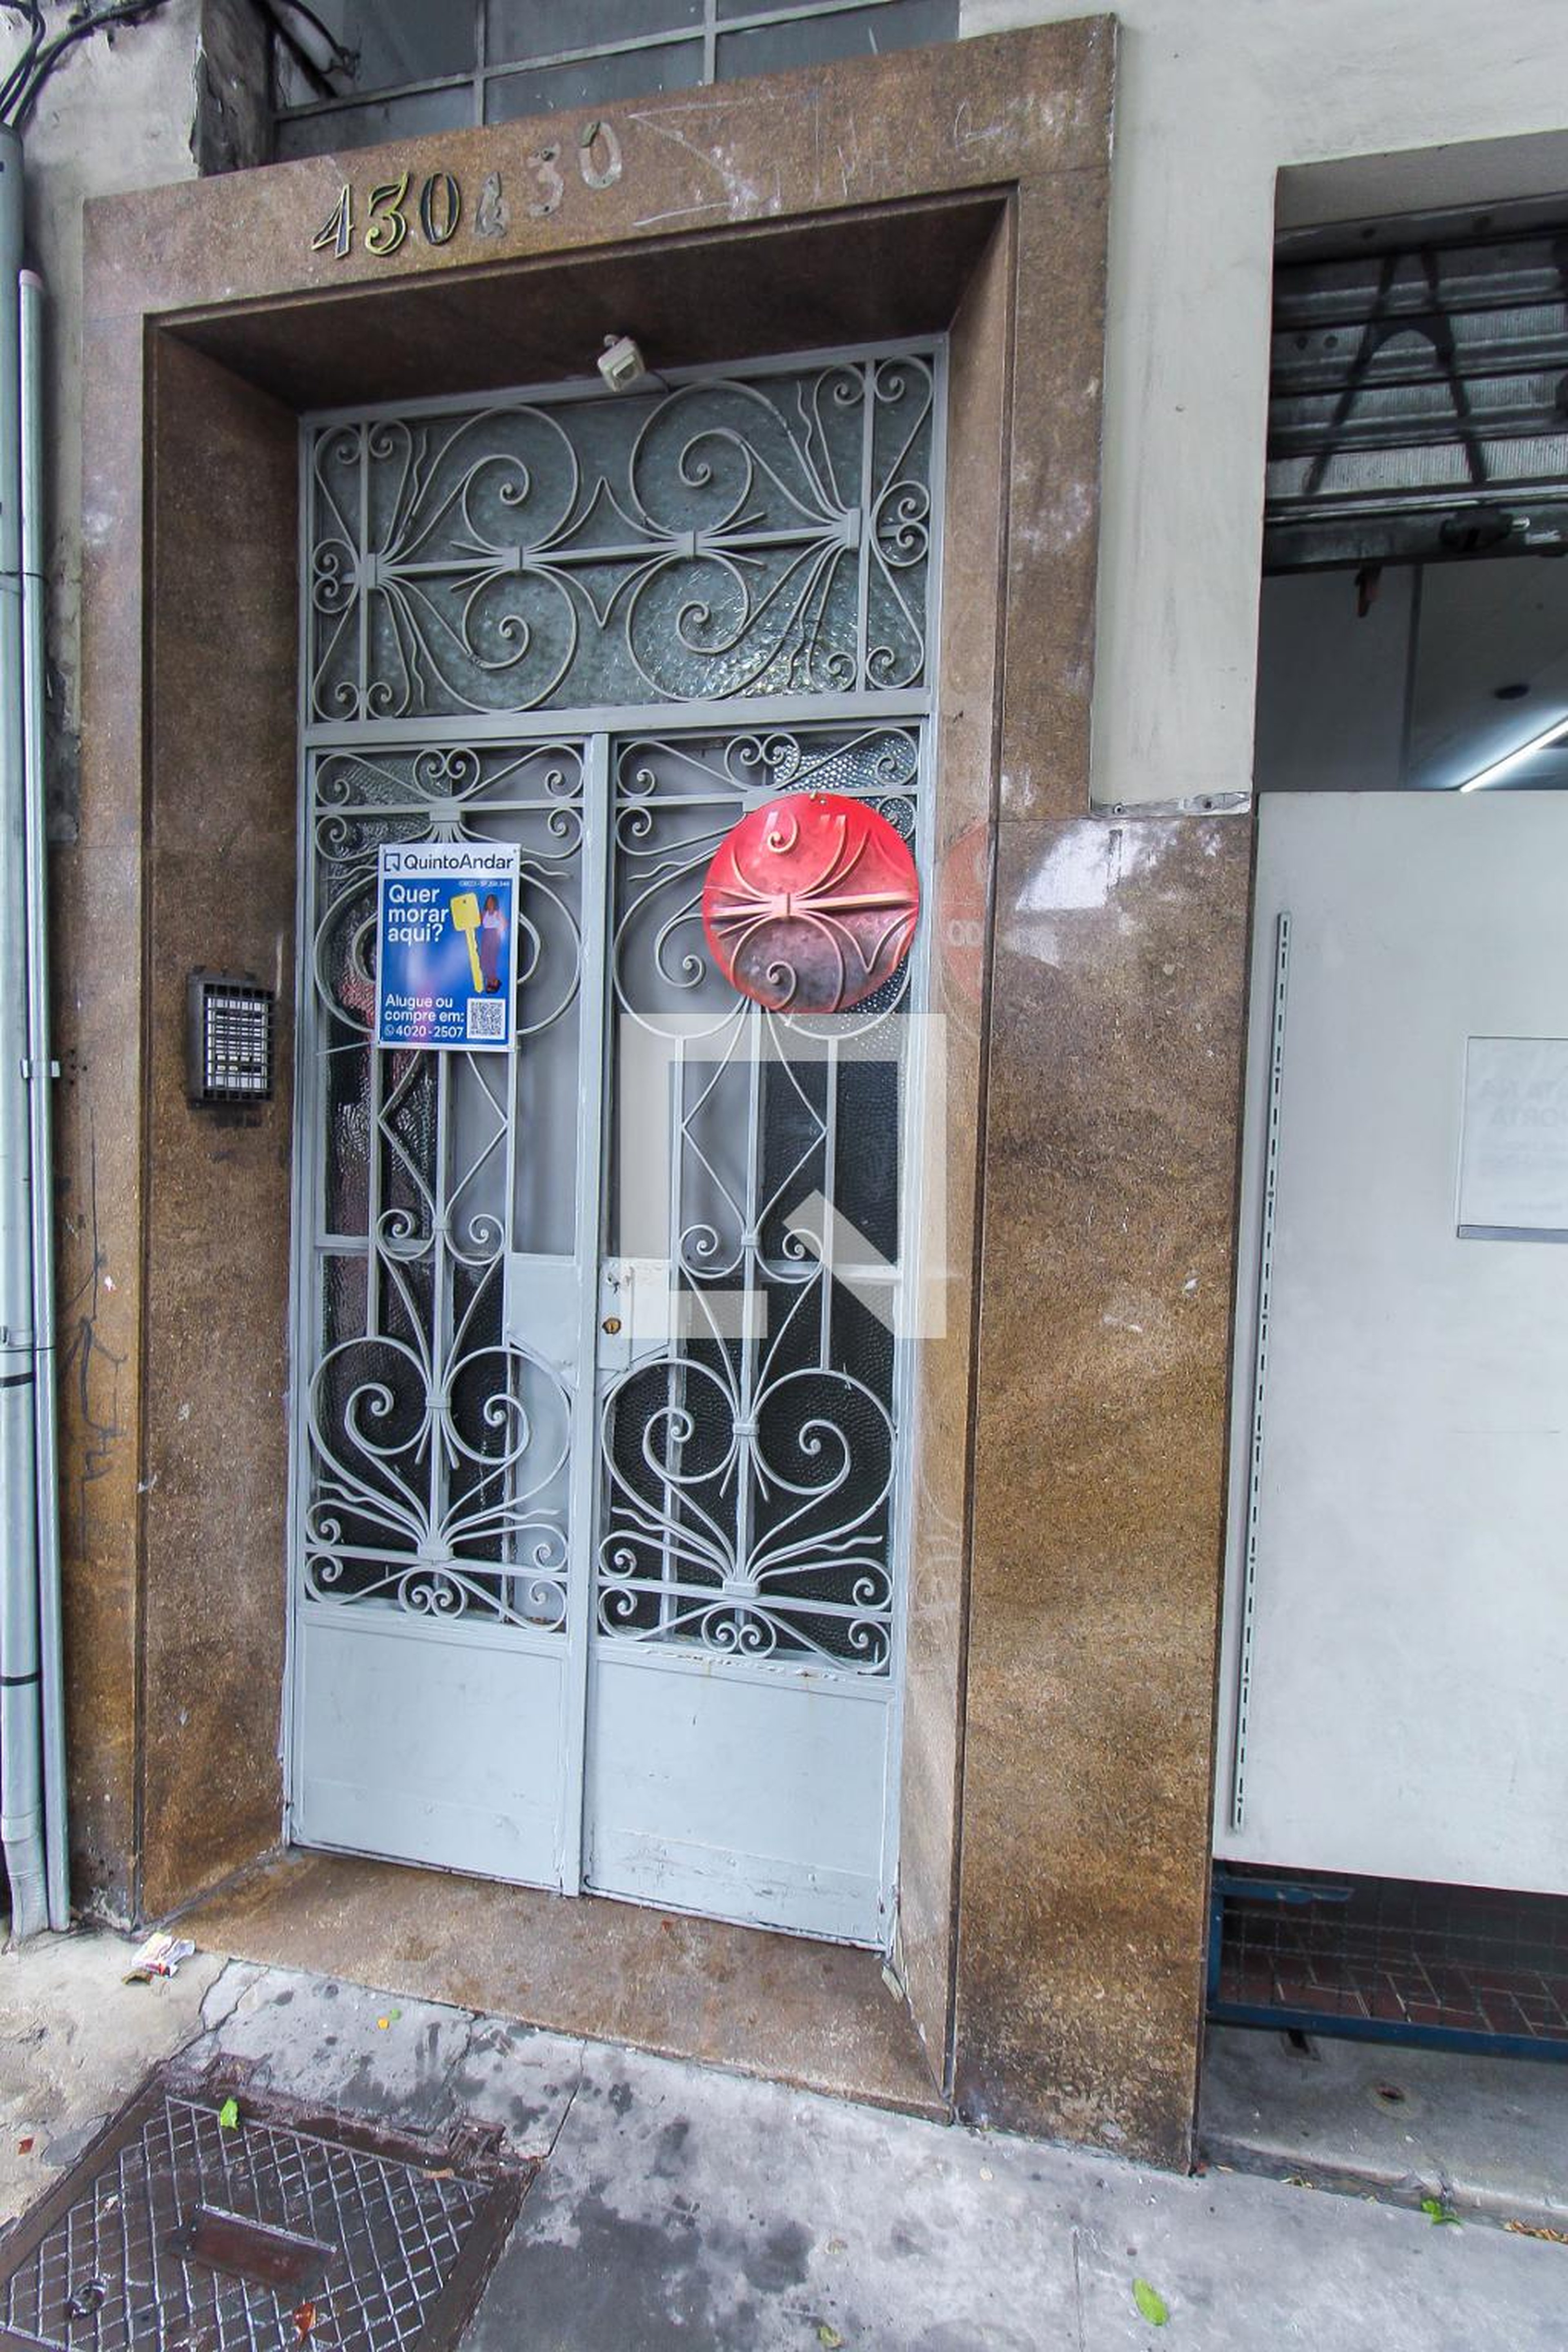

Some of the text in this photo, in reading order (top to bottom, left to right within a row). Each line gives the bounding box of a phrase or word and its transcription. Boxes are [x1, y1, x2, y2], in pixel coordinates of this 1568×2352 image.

[311, 170, 461, 260] 430
[404, 853, 514, 871] QuintoAndar
[388, 884, 440, 903] Quer
[388, 908, 449, 923] morar
[388, 924, 443, 947] aqui?
[385, 994, 453, 1010] Alugue ou
[384, 1011, 464, 1024] compre em:
